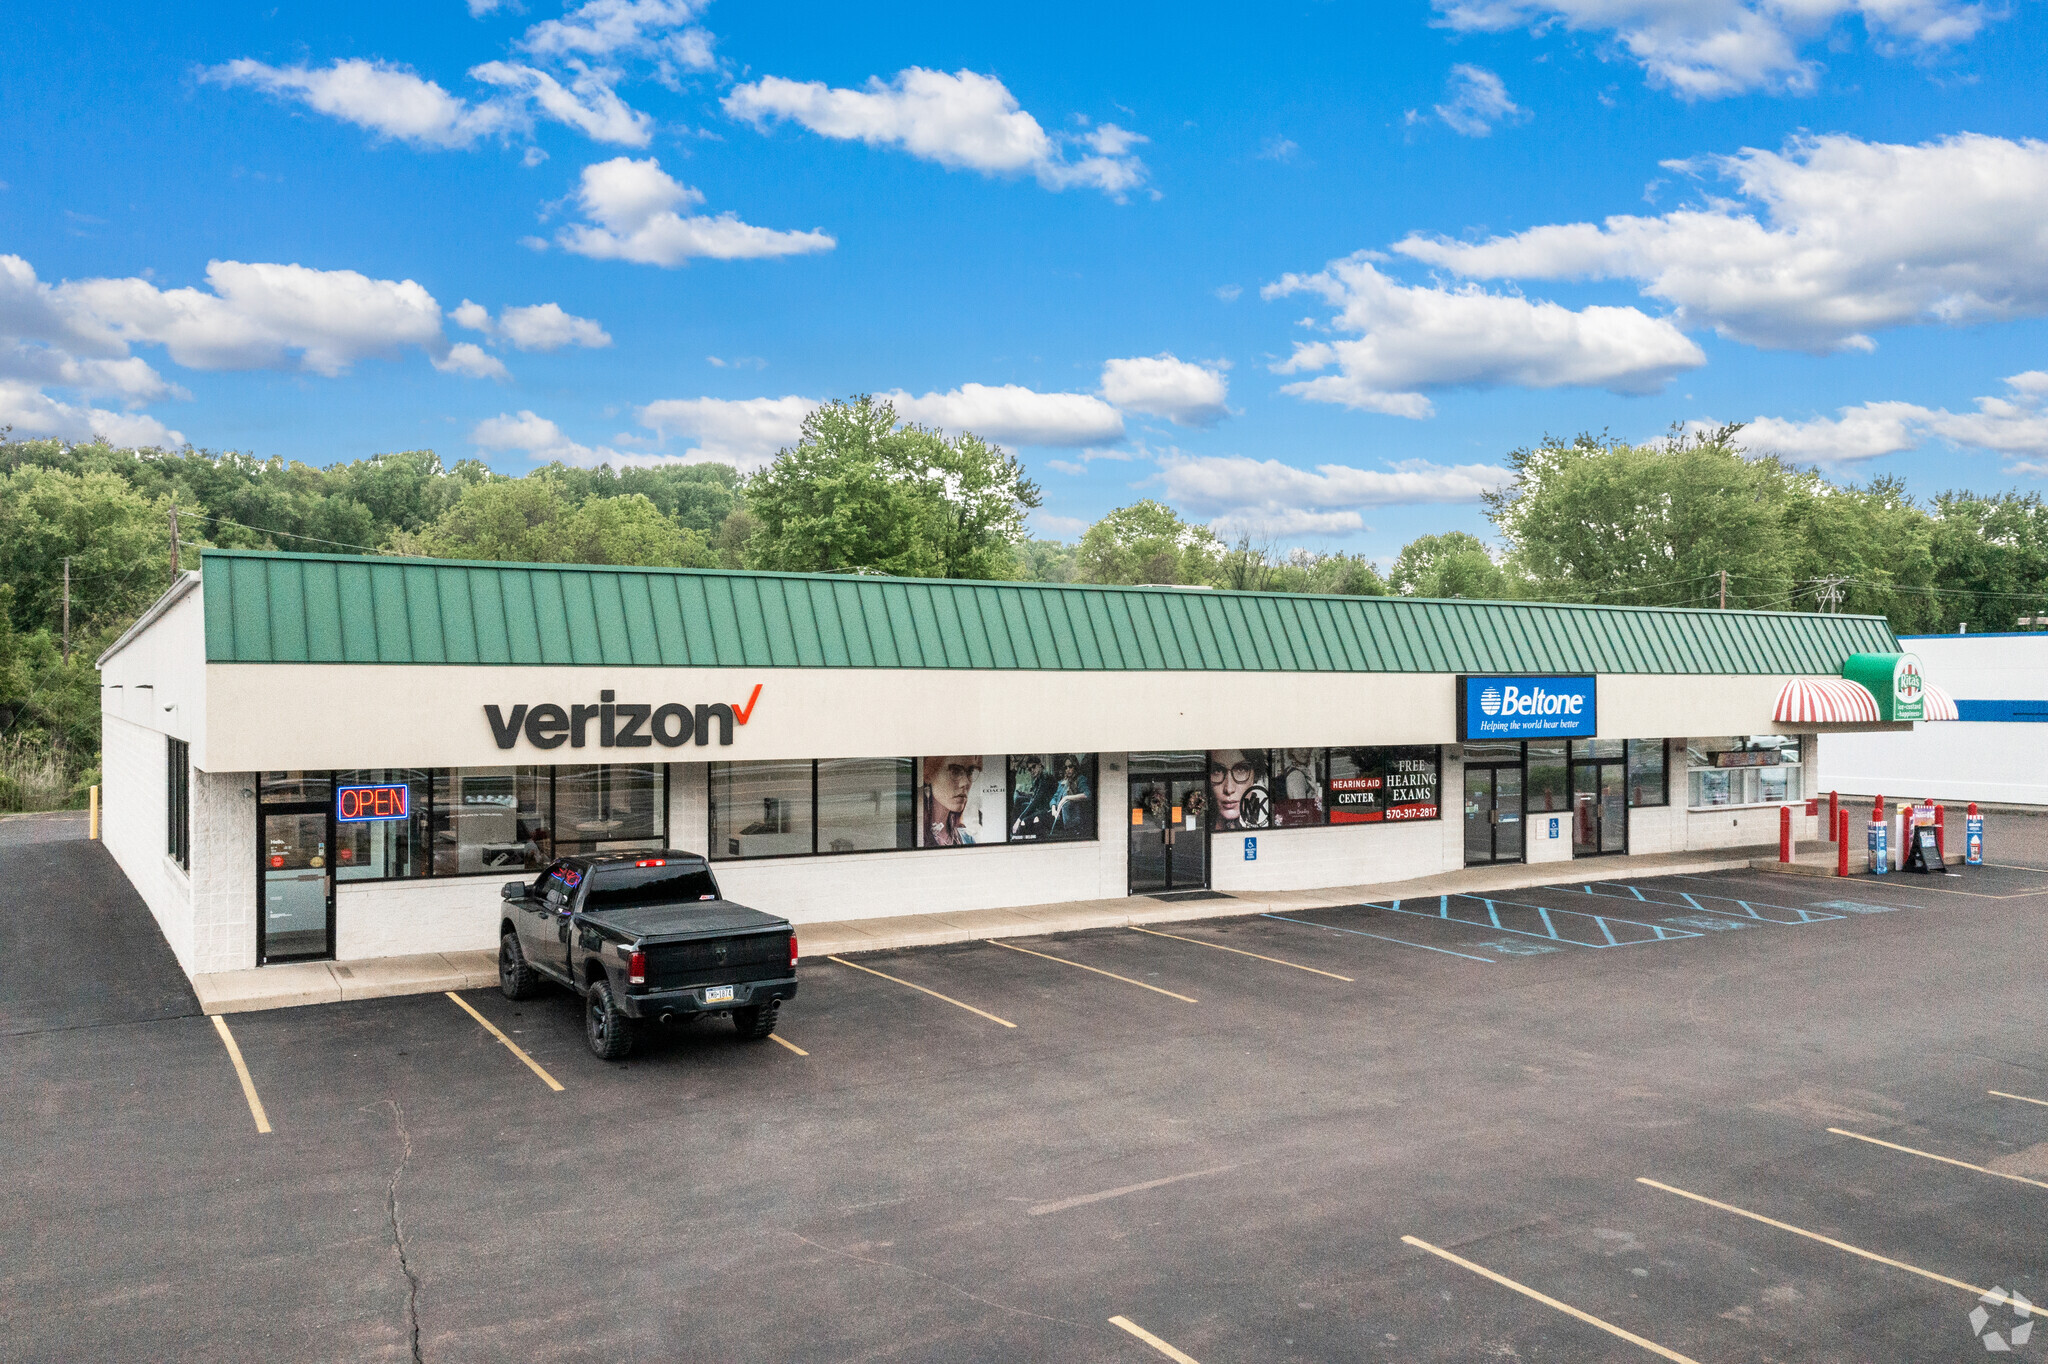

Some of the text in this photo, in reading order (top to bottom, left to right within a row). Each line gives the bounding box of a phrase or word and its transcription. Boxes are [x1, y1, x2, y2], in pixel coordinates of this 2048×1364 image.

[1901, 673, 1919, 689] Rita's
[1501, 686, 1583, 715] Beltone
[483, 689, 734, 750] verizon
[1480, 719, 1579, 732] Helping the world hear better
[1399, 759, 1426, 772] FREE
[1332, 779, 1380, 789] HEARING AID
[1386, 773, 1437, 787] HEARING
[1338, 792, 1375, 804] CENTER
[1393, 787, 1431, 801] EXAMS
[341, 788, 405, 817] OPEN
[1386, 807, 1438, 819] 570-317-2817
